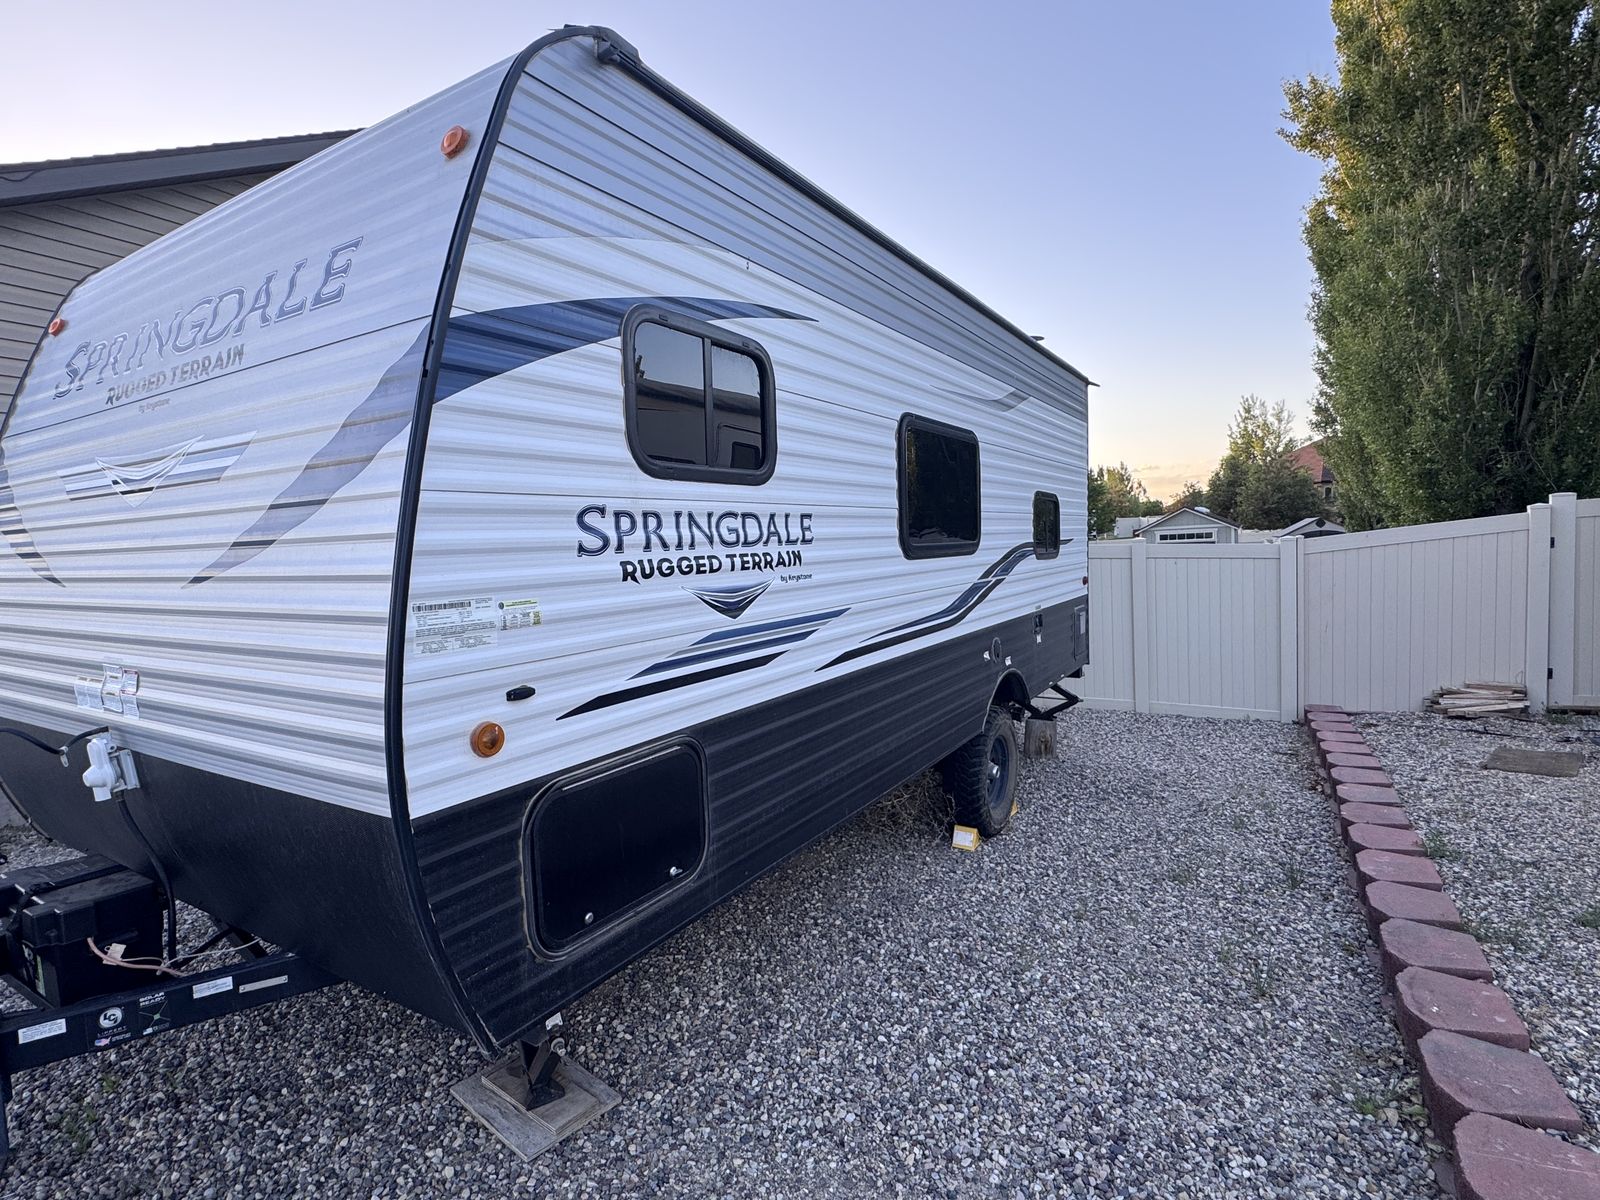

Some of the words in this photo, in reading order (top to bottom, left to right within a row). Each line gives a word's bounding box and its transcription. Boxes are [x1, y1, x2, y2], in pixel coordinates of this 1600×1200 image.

[53, 236, 364, 400] SPRINGDALE
[105, 369, 168, 406] RUGGED
[169, 343, 245, 386] TERRAIN
[576, 504, 814, 557] SPRINGDALE
[619, 554, 723, 585] RUGGED
[725, 549, 802, 573] TERRAIN
[780, 574, 789, 584] by
